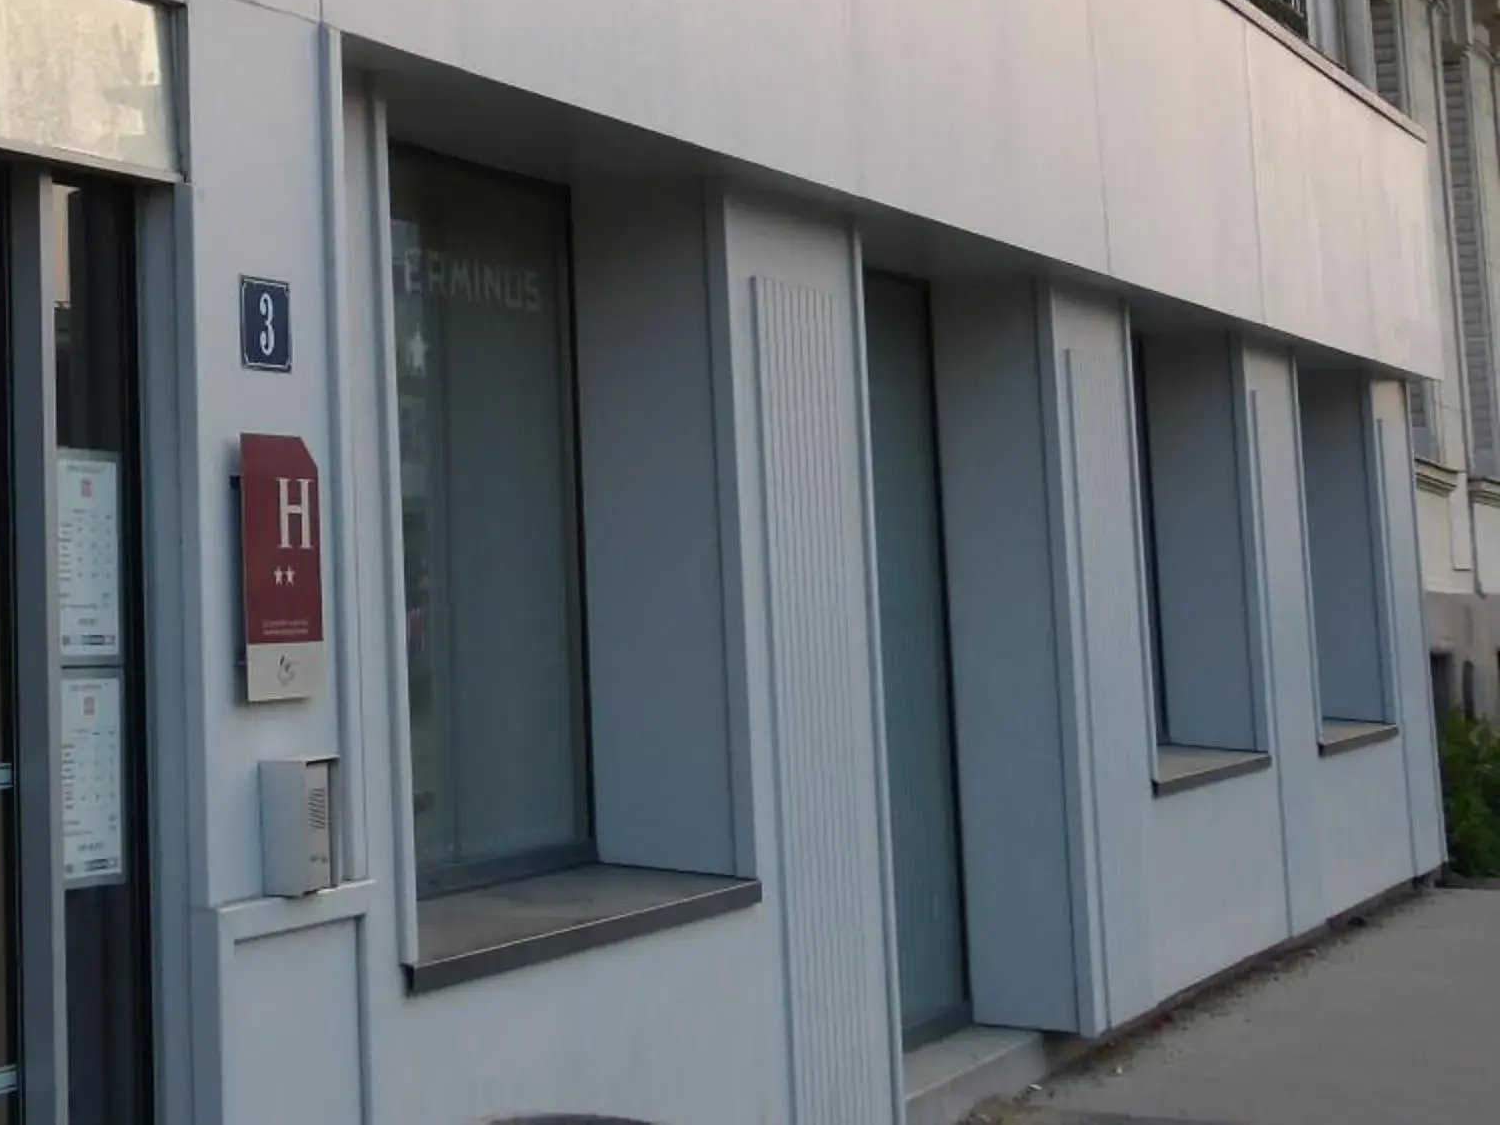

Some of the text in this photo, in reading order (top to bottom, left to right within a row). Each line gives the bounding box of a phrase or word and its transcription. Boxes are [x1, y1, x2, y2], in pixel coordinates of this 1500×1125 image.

[403, 247, 542, 312] ERMINUS
[259, 292, 275, 356] 3
[276, 477, 314, 549] H
